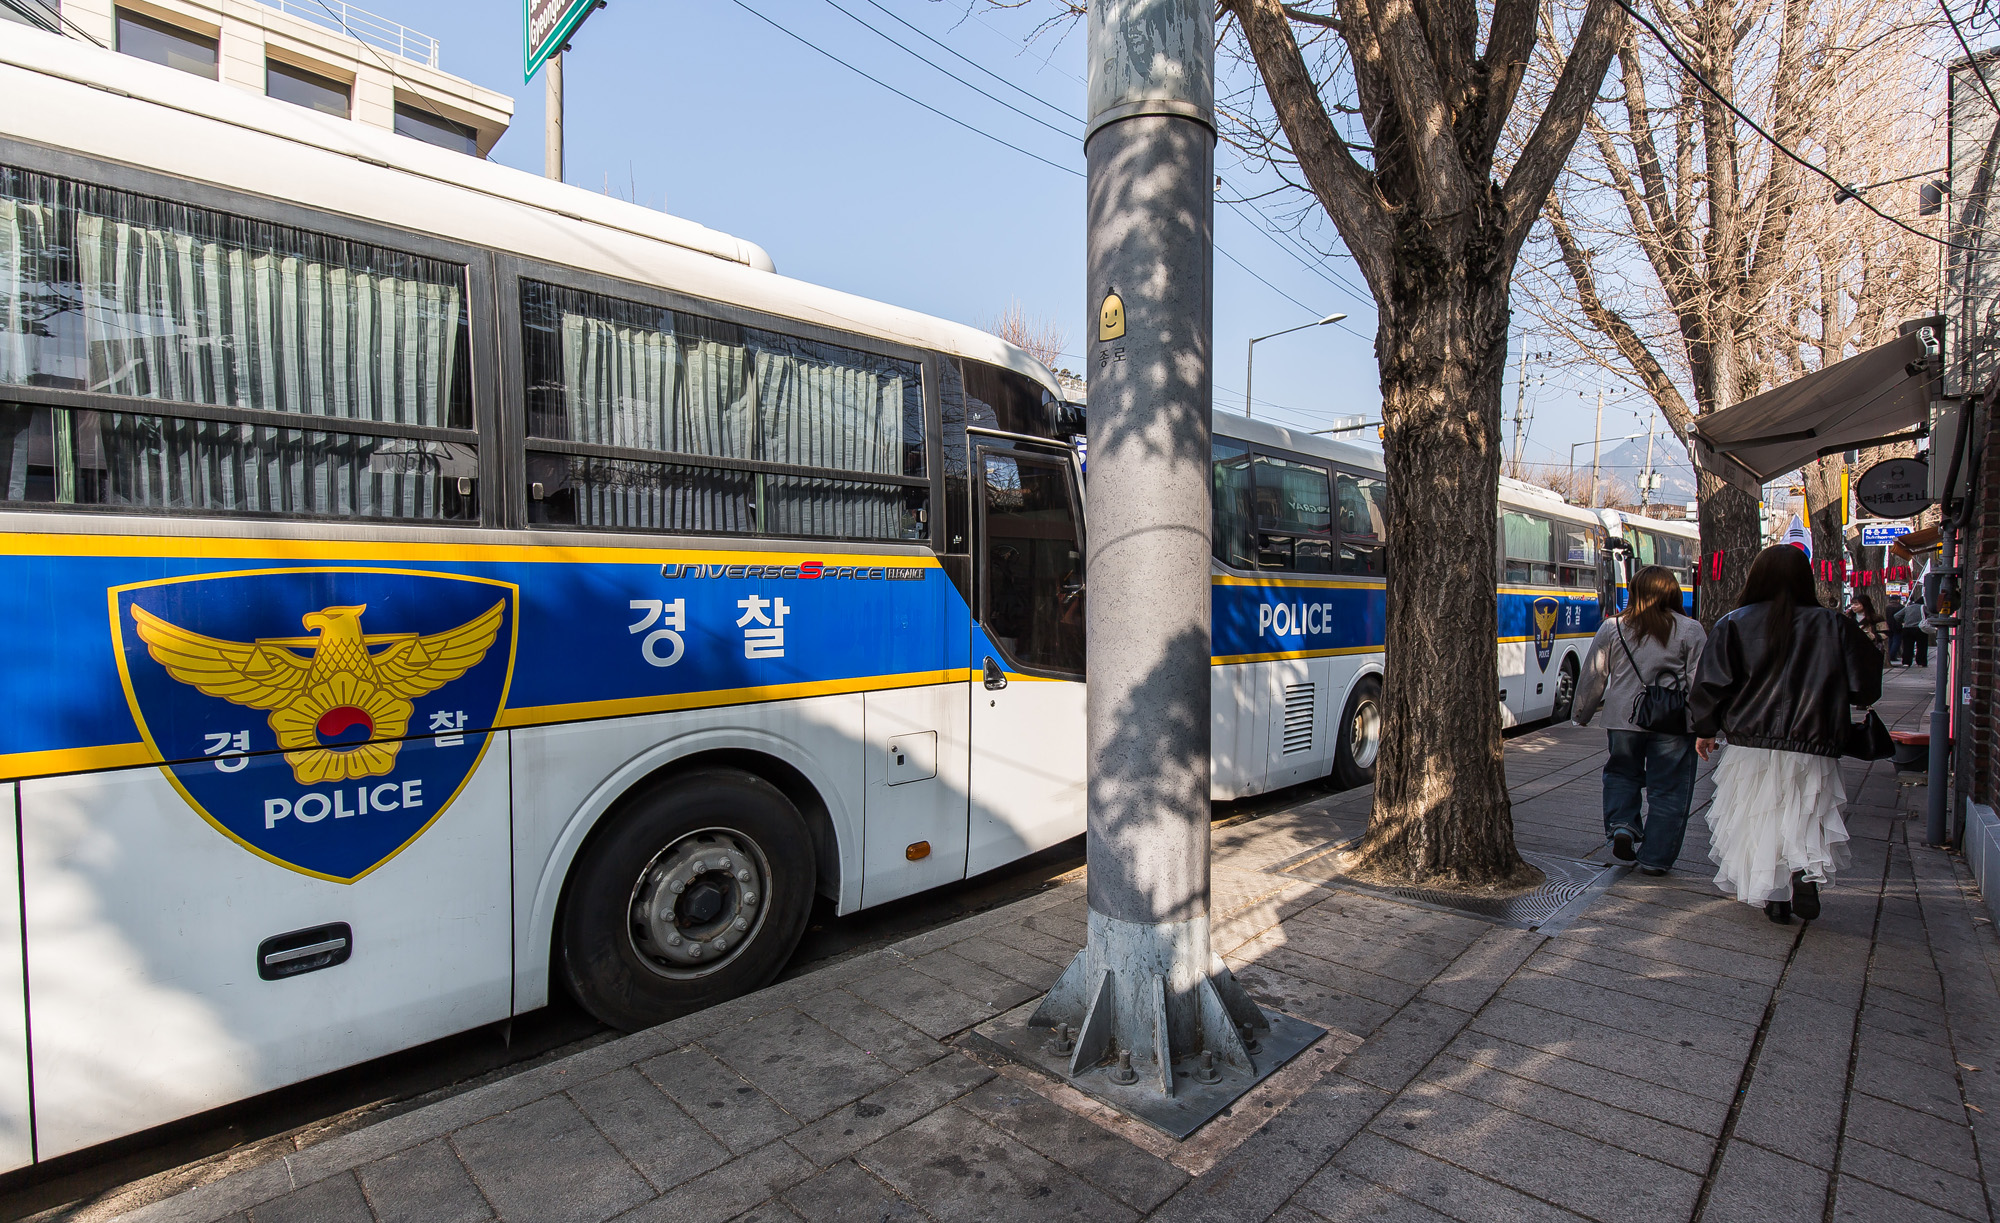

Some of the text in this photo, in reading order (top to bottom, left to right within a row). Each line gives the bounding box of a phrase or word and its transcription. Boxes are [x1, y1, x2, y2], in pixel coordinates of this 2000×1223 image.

[1098, 347, 1126, 368] 종로
[887, 568, 924, 579] ELEGANCE
[1259, 602, 1332, 637] POLICE
[1539, 650, 1549, 658] POLICE
[264, 779, 424, 829] POLICE
